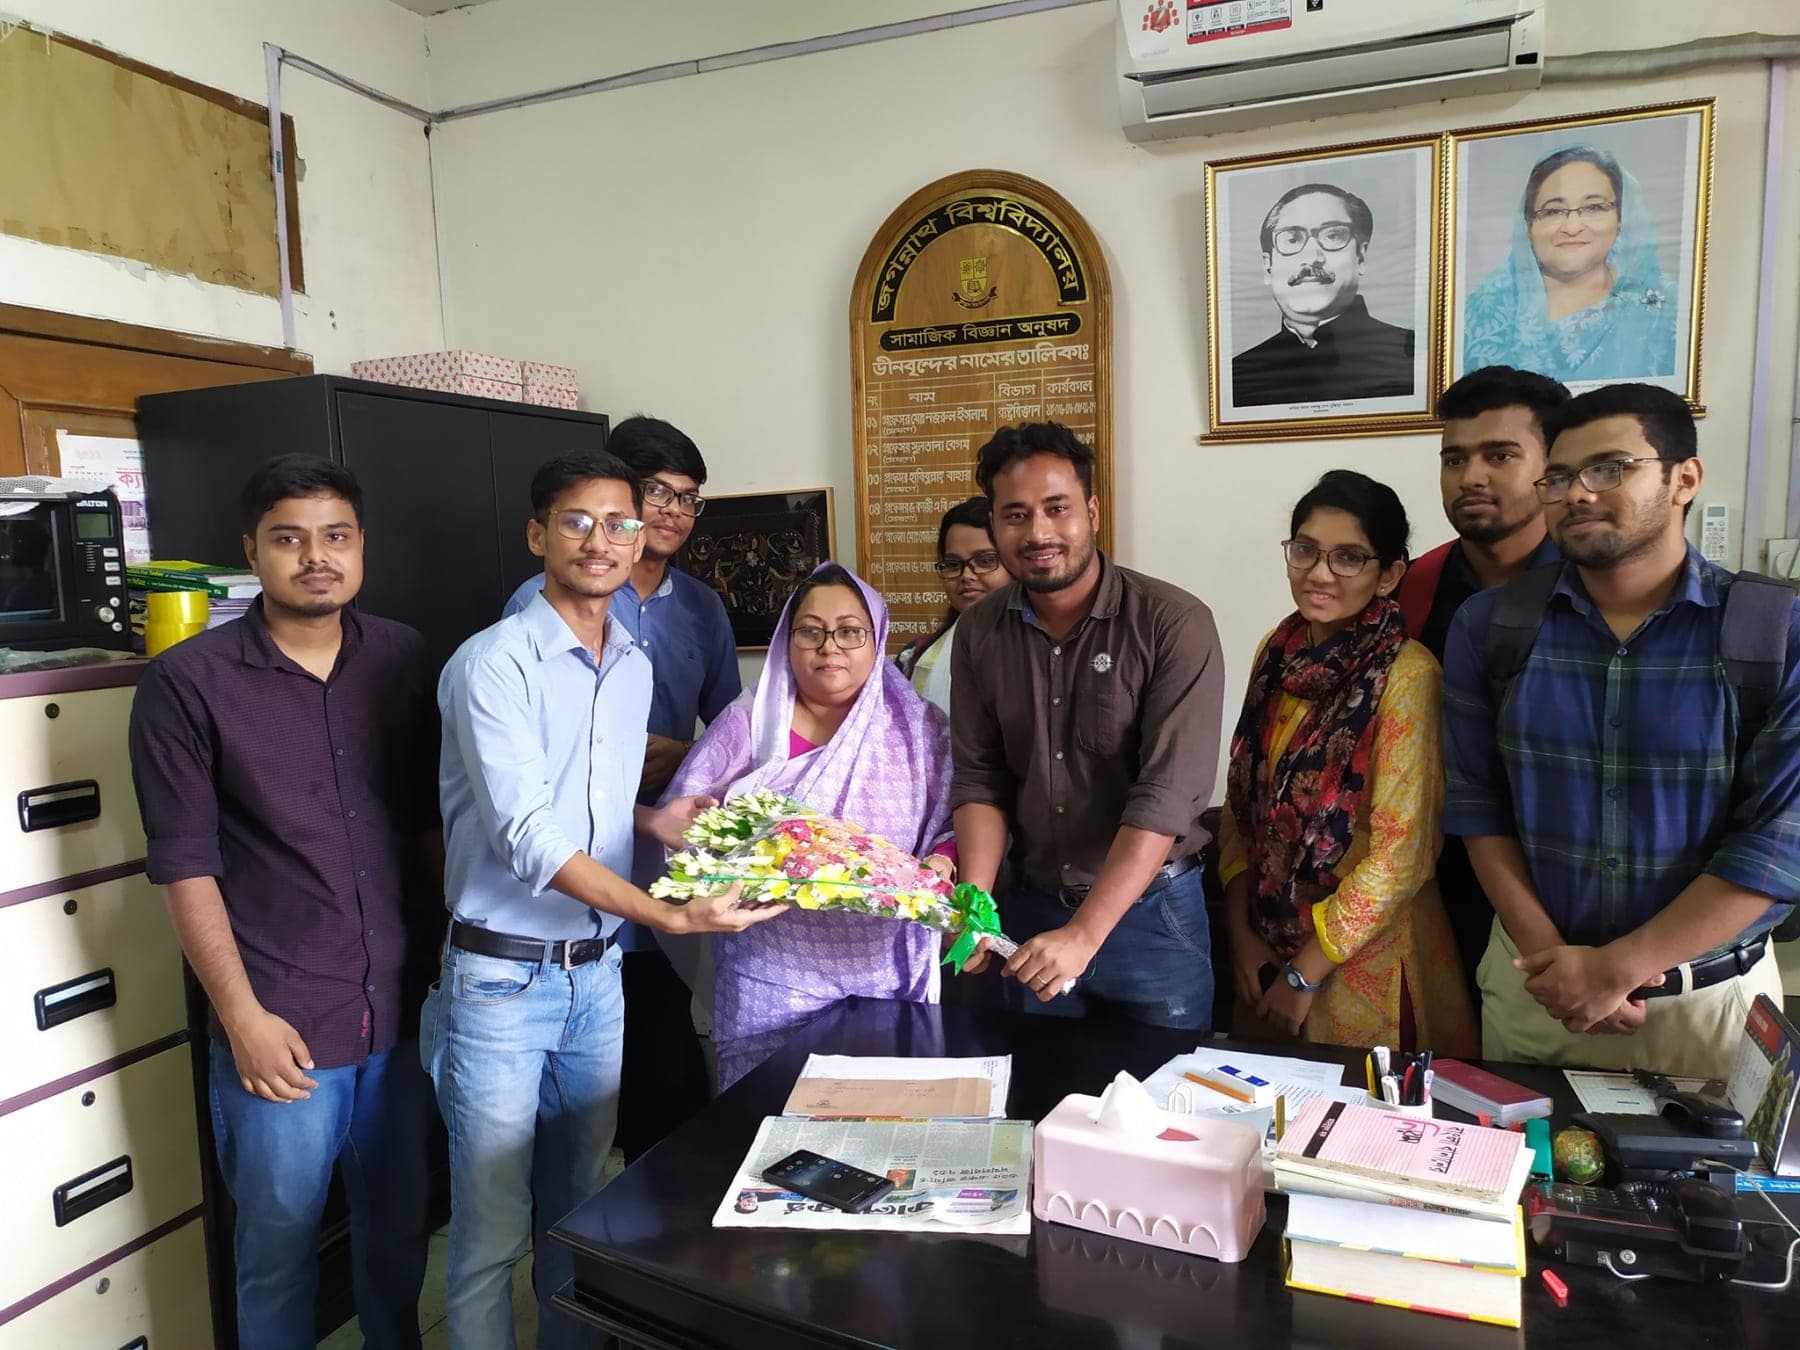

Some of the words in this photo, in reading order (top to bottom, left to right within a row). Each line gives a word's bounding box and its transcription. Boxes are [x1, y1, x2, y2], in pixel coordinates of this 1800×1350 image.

[877, 217, 937, 315] জগন্নাথ
[946, 200, 1080, 293] বিশ্ববিদ্যালয়
[890, 327, 957, 348] সামাজিক
[962, 324, 1011, 341] বিজ্ঞান
[1018, 318, 1070, 337] অনুষদ
[909, 391, 936, 403] নাম
[998, 383, 1036, 398] বিভাগ
[1046, 377, 1093, 394] কার্যকাল
[957, 407, 988, 422] ইসলাম
[946, 439, 970, 452] বেগম
[1439, 1126, 1465, 1147] বাংলা
